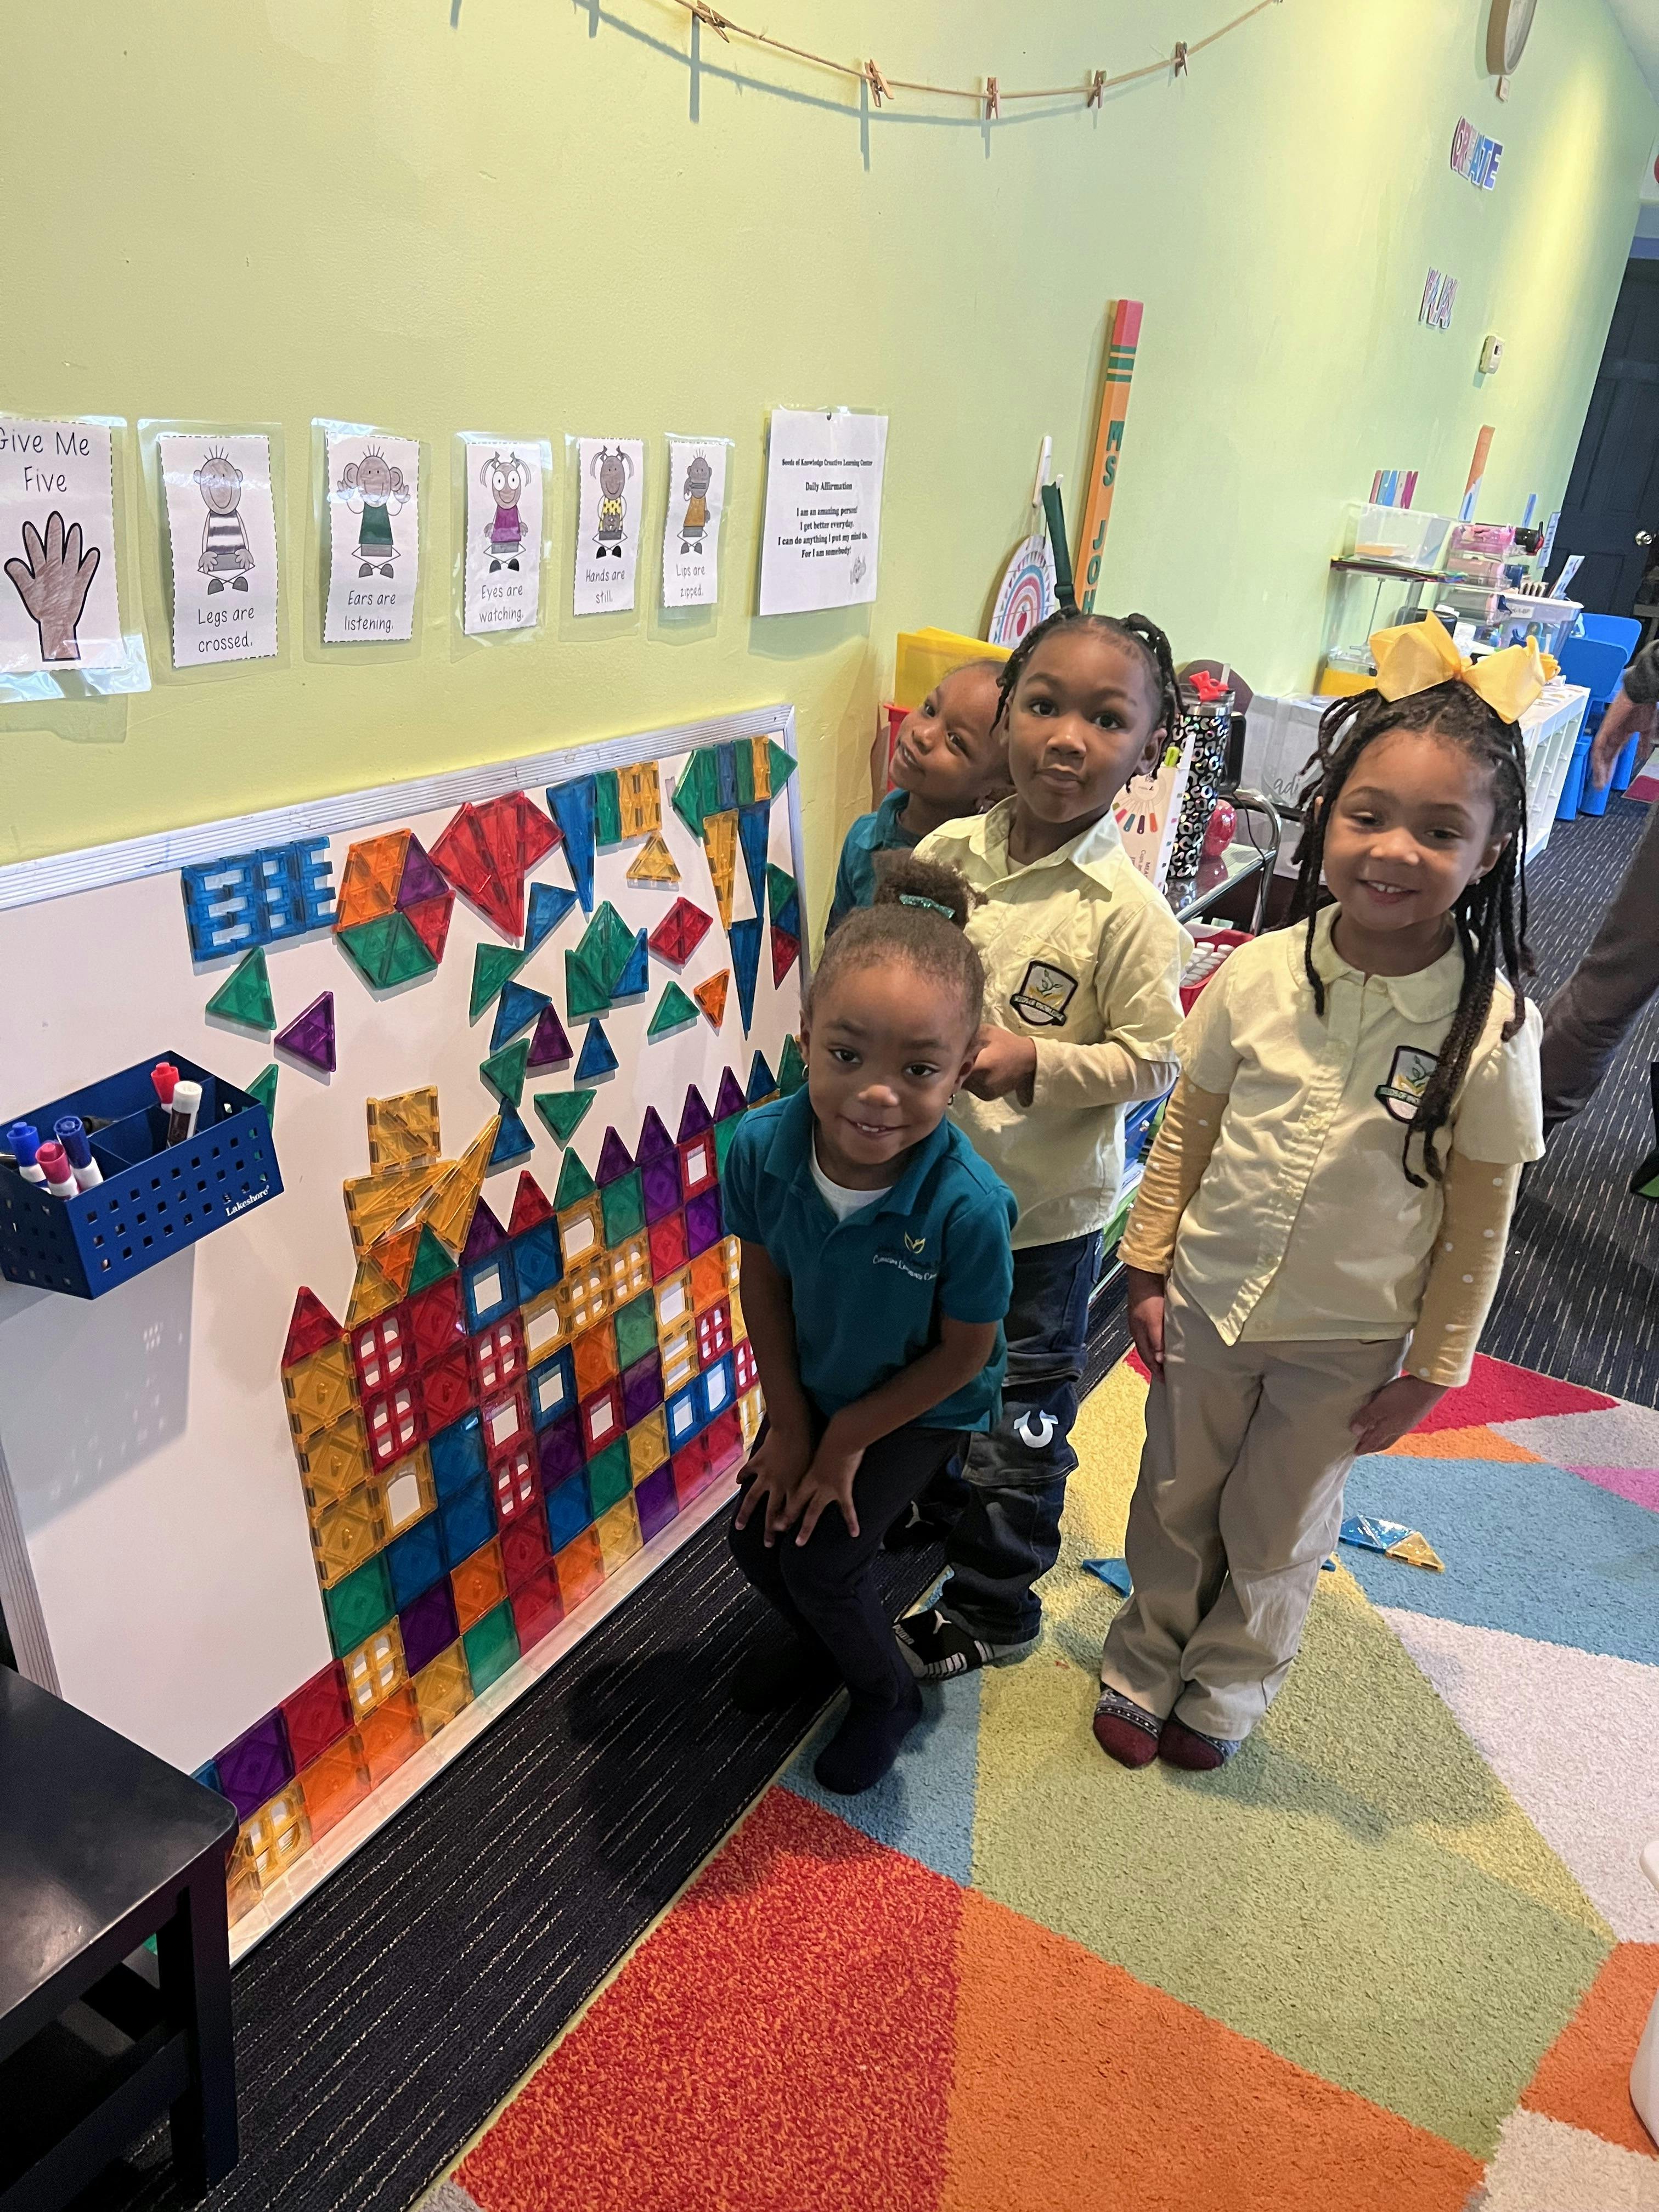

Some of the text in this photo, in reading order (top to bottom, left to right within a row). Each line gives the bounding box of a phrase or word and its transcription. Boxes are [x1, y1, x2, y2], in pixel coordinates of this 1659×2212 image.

[1451, 115, 1503, 191] CREATE
[56, 431, 89, 456] Me
[1103, 420, 1125, 487] MS
[24, 466, 67, 492] Five
[805, 482, 853, 493] Daily Affirmation
[817, 506, 839, 517] amazing
[804, 523, 812, 532] get
[813, 521, 830, 529] better
[795, 536, 802, 544] do
[803, 534, 828, 545] anything
[832, 534, 841, 544] put
[850, 532, 861, 540] mind
[802, 549, 811, 558] For
[585, 568, 625, 583] Hands are
[676, 563, 705, 579] Lips are
[348, 590, 396, 605] Ears are
[482, 584, 523, 601] Eyes are
[596, 589, 613, 604] still.
[680, 583, 703, 599] zipped.
[198, 607, 255, 627] Legs are
[479, 606, 524, 623] watching.
[345, 615, 394, 633] listening.
[198, 630, 252, 652] crossed.
[225, 1187, 269, 1217] Lakeshore
[892, 1624, 915, 1645] PUMA
